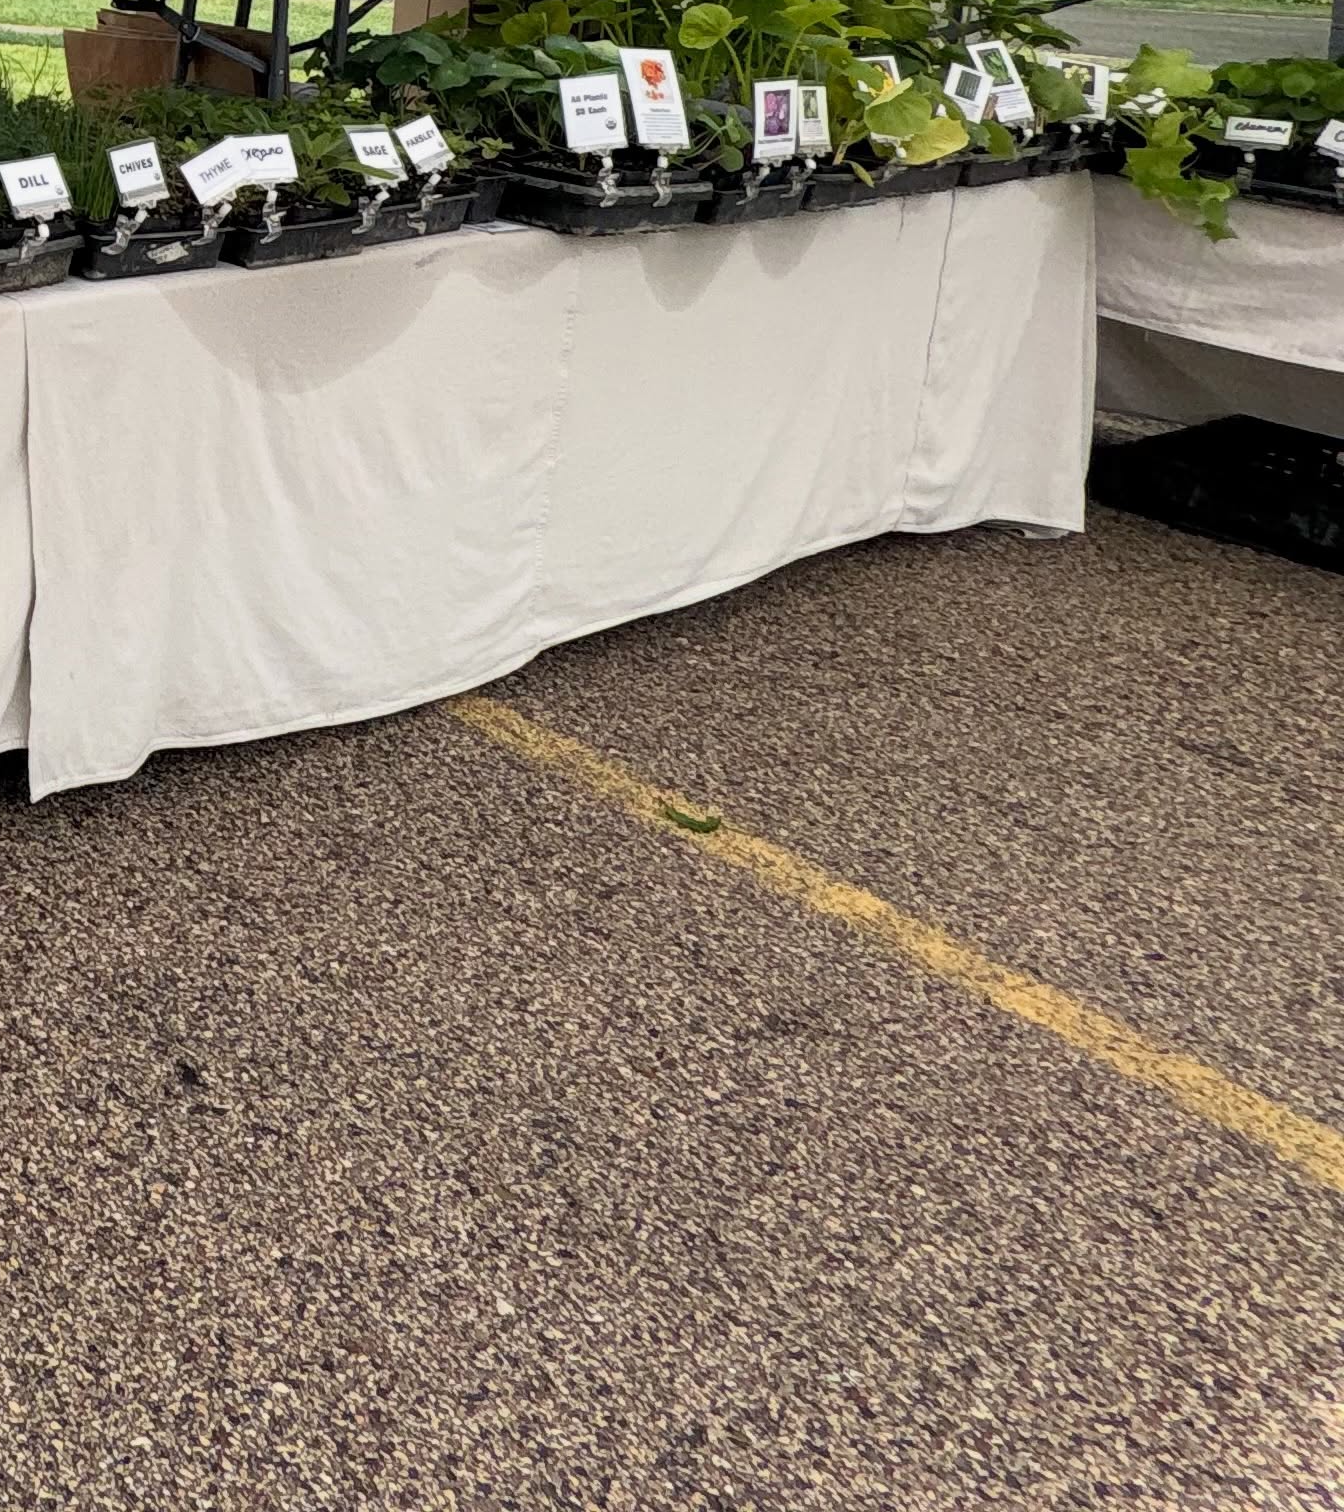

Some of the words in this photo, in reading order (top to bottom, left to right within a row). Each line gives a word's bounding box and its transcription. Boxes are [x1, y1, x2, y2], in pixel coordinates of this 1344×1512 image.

[362, 144, 389, 156] SAGE
[119, 157, 154, 175] CHIVES
[199, 157, 233, 184] THYME
[18, 173, 50, 189] DILL
